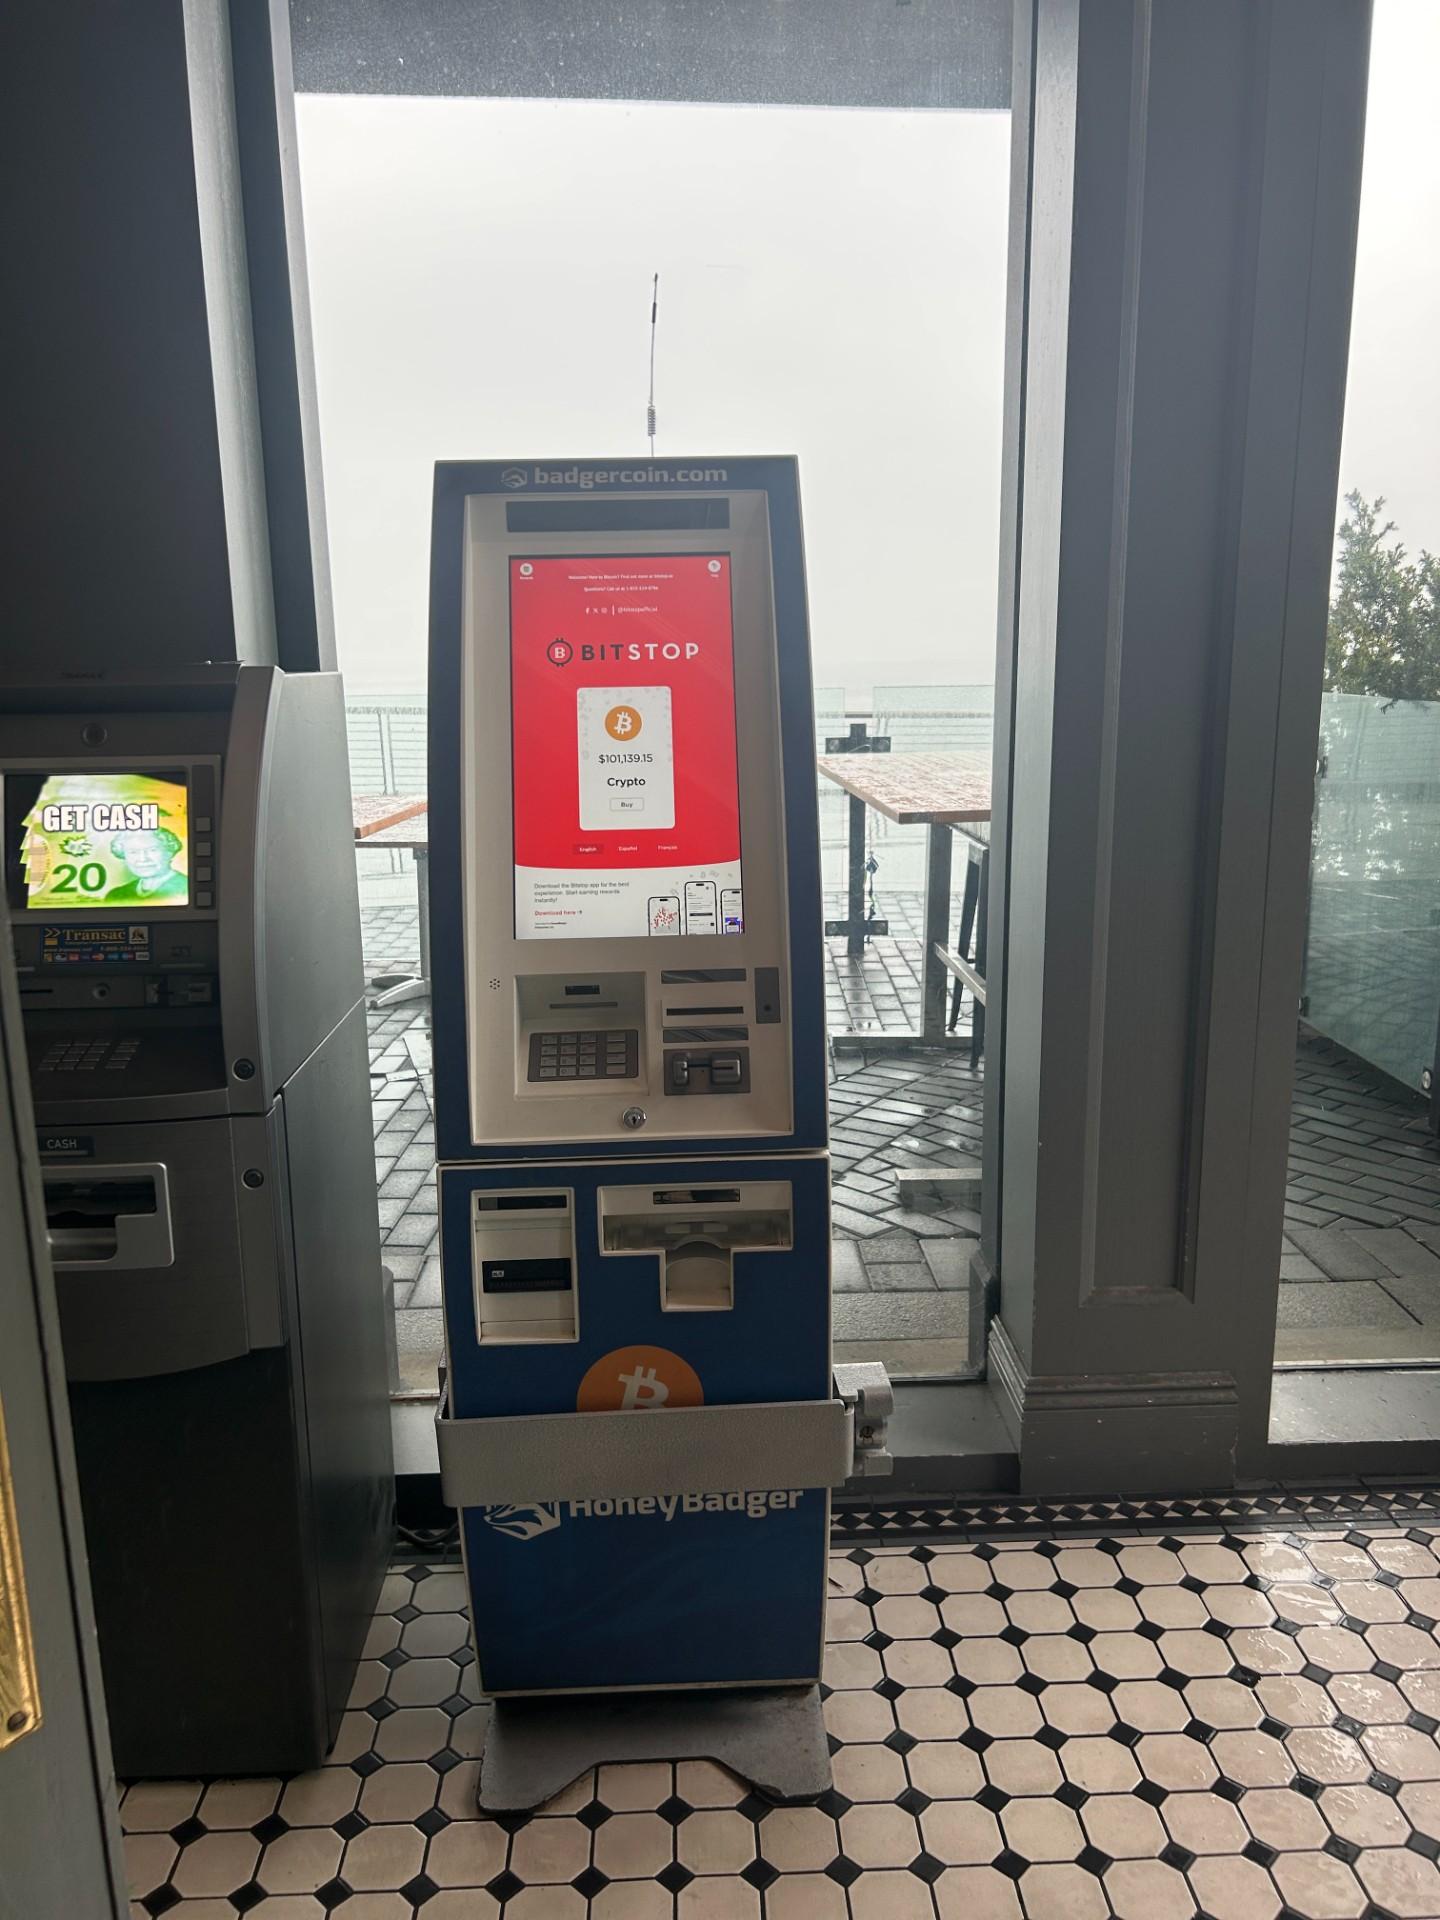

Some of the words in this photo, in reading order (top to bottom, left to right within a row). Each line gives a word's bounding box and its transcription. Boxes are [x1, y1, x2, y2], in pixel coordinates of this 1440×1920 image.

[534, 466, 728, 489] badgercoin.com
[581, 642, 699, 661] BITSTOP
[598, 753, 654, 764] $101,139.15
[607, 777, 646, 788] Crypto
[42, 804, 89, 832] GET
[92, 803, 159, 832] CASH
[50, 862, 107, 894] 20
[62, 929, 126, 941] Transac
[46, 1138, 77, 1149] CASH
[569, 1489, 804, 1522] HoneyBadger
